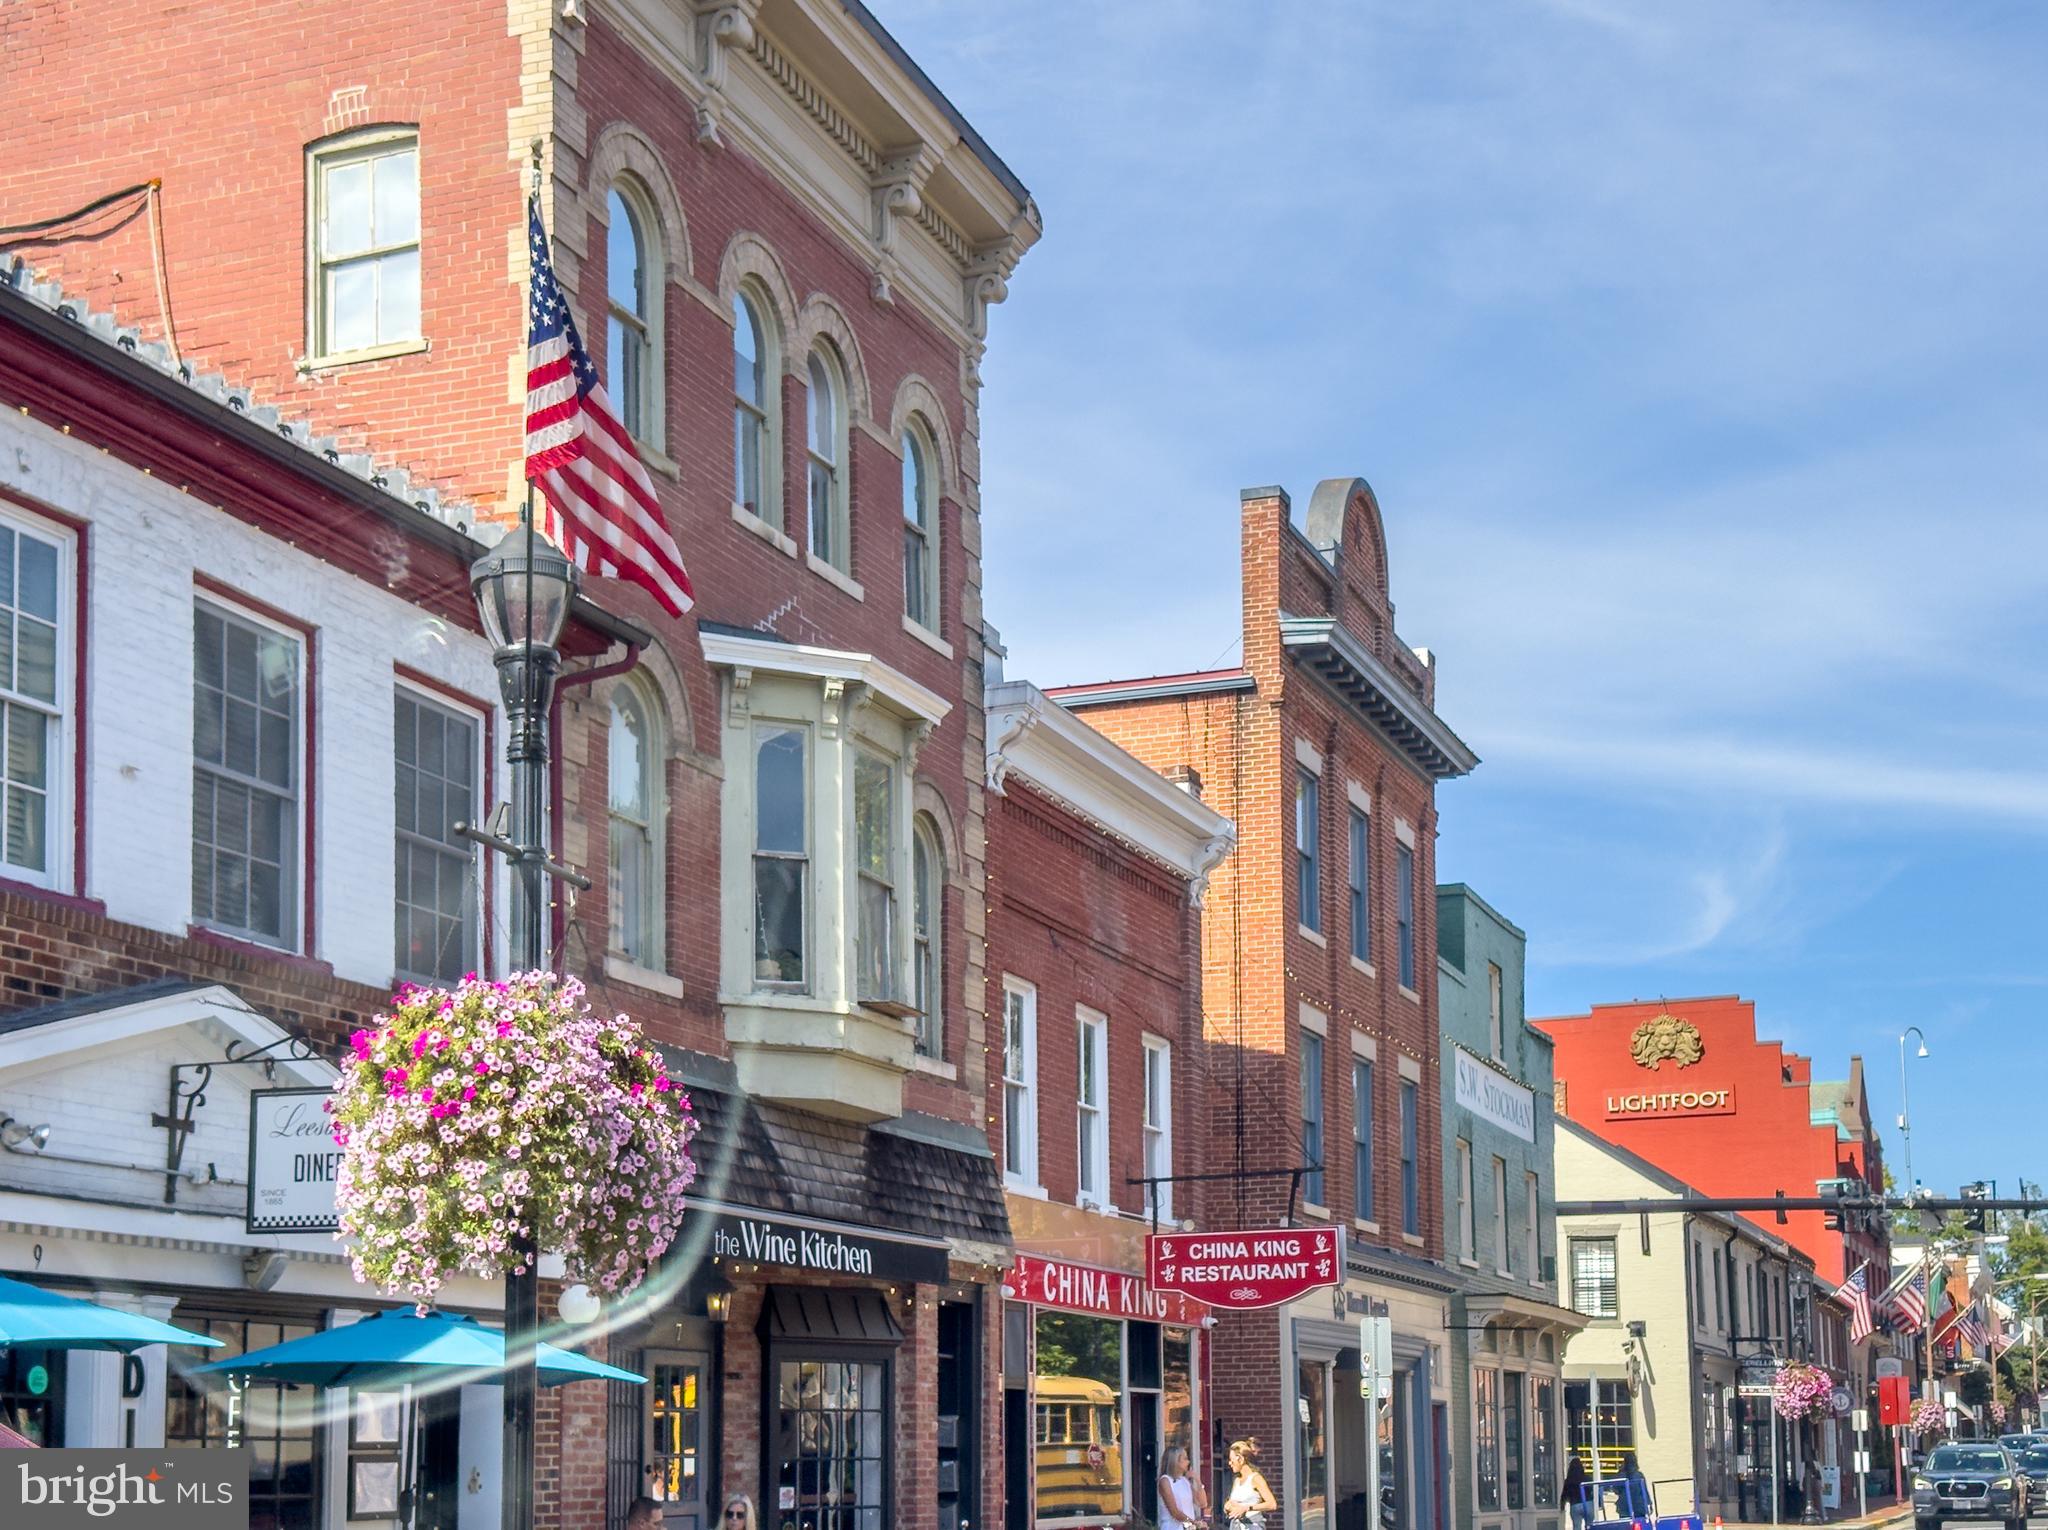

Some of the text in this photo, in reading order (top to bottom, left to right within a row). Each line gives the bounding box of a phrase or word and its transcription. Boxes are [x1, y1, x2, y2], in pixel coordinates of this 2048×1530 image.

[1607, 1091, 1729, 1112] LIGHTFOOT
[260, 1188, 287, 1198] SINCE
[33, 1244, 43, 1270] 9
[714, 1220, 873, 1275] the Wine Kitchen
[1189, 1241, 1249, 1260] CHINA
[1254, 1240, 1301, 1257] KING
[1181, 1262, 1310, 1283] RESTAURANT
[1043, 1263, 1111, 1311] CHINA
[1120, 1276, 1168, 1318] KING
